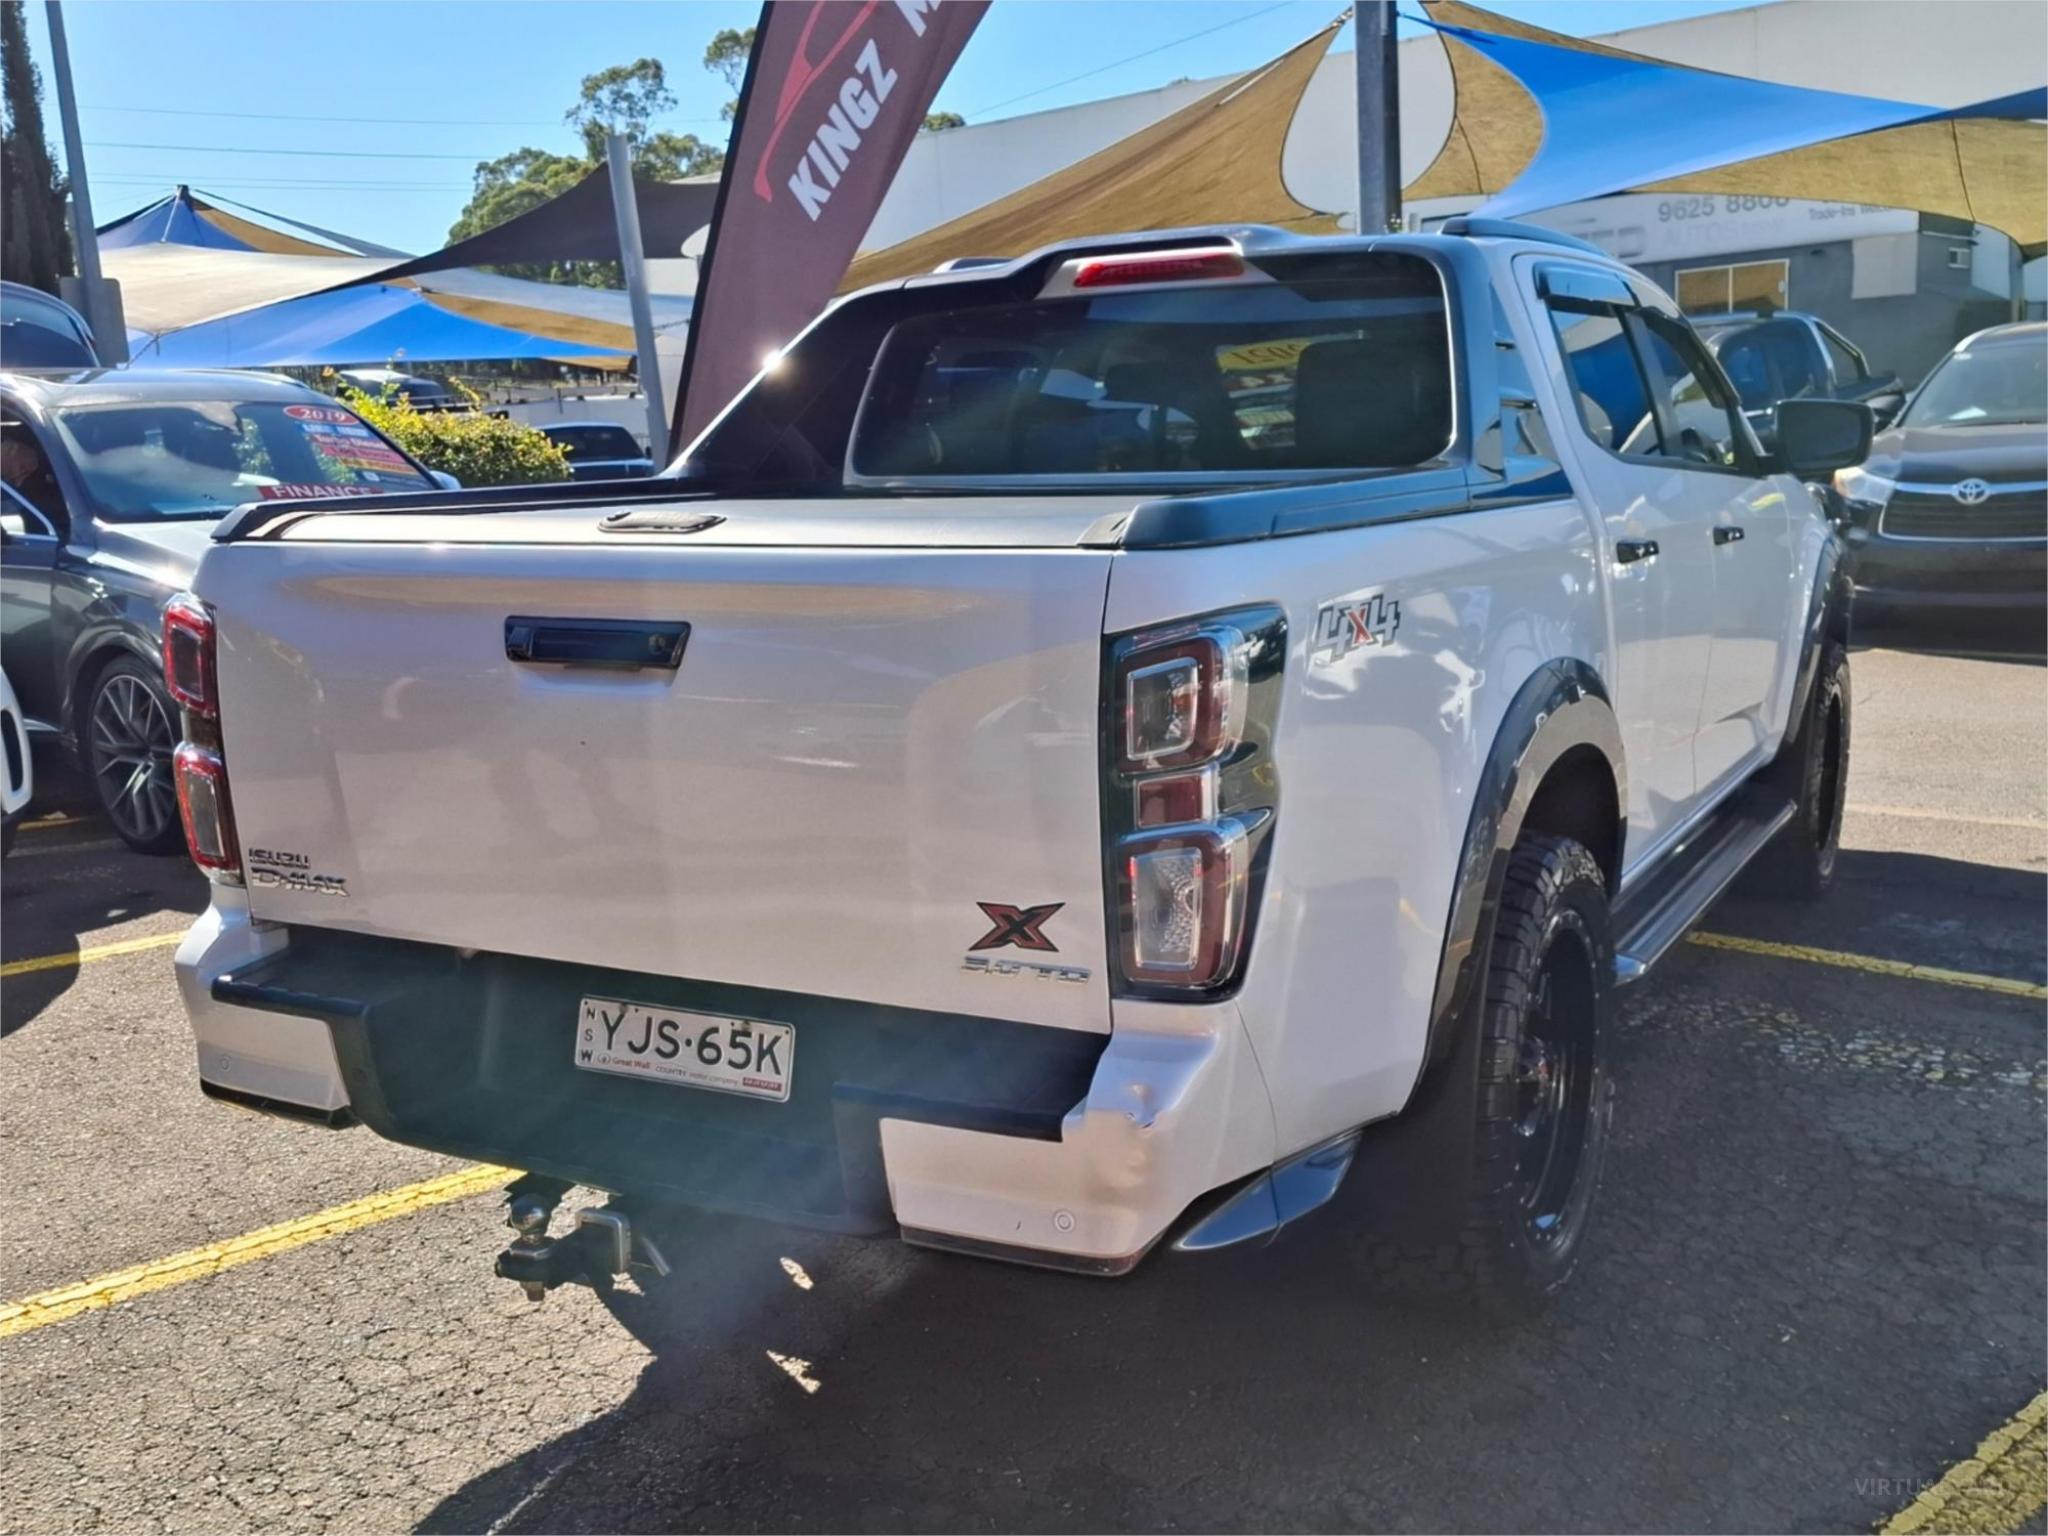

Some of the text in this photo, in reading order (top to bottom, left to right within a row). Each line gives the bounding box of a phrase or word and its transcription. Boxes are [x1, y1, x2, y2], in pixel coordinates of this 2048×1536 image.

[788, 38, 898, 221] KINGZ
[1657, 196, 1715, 222] 9625
[301, 408, 346, 421] 2019
